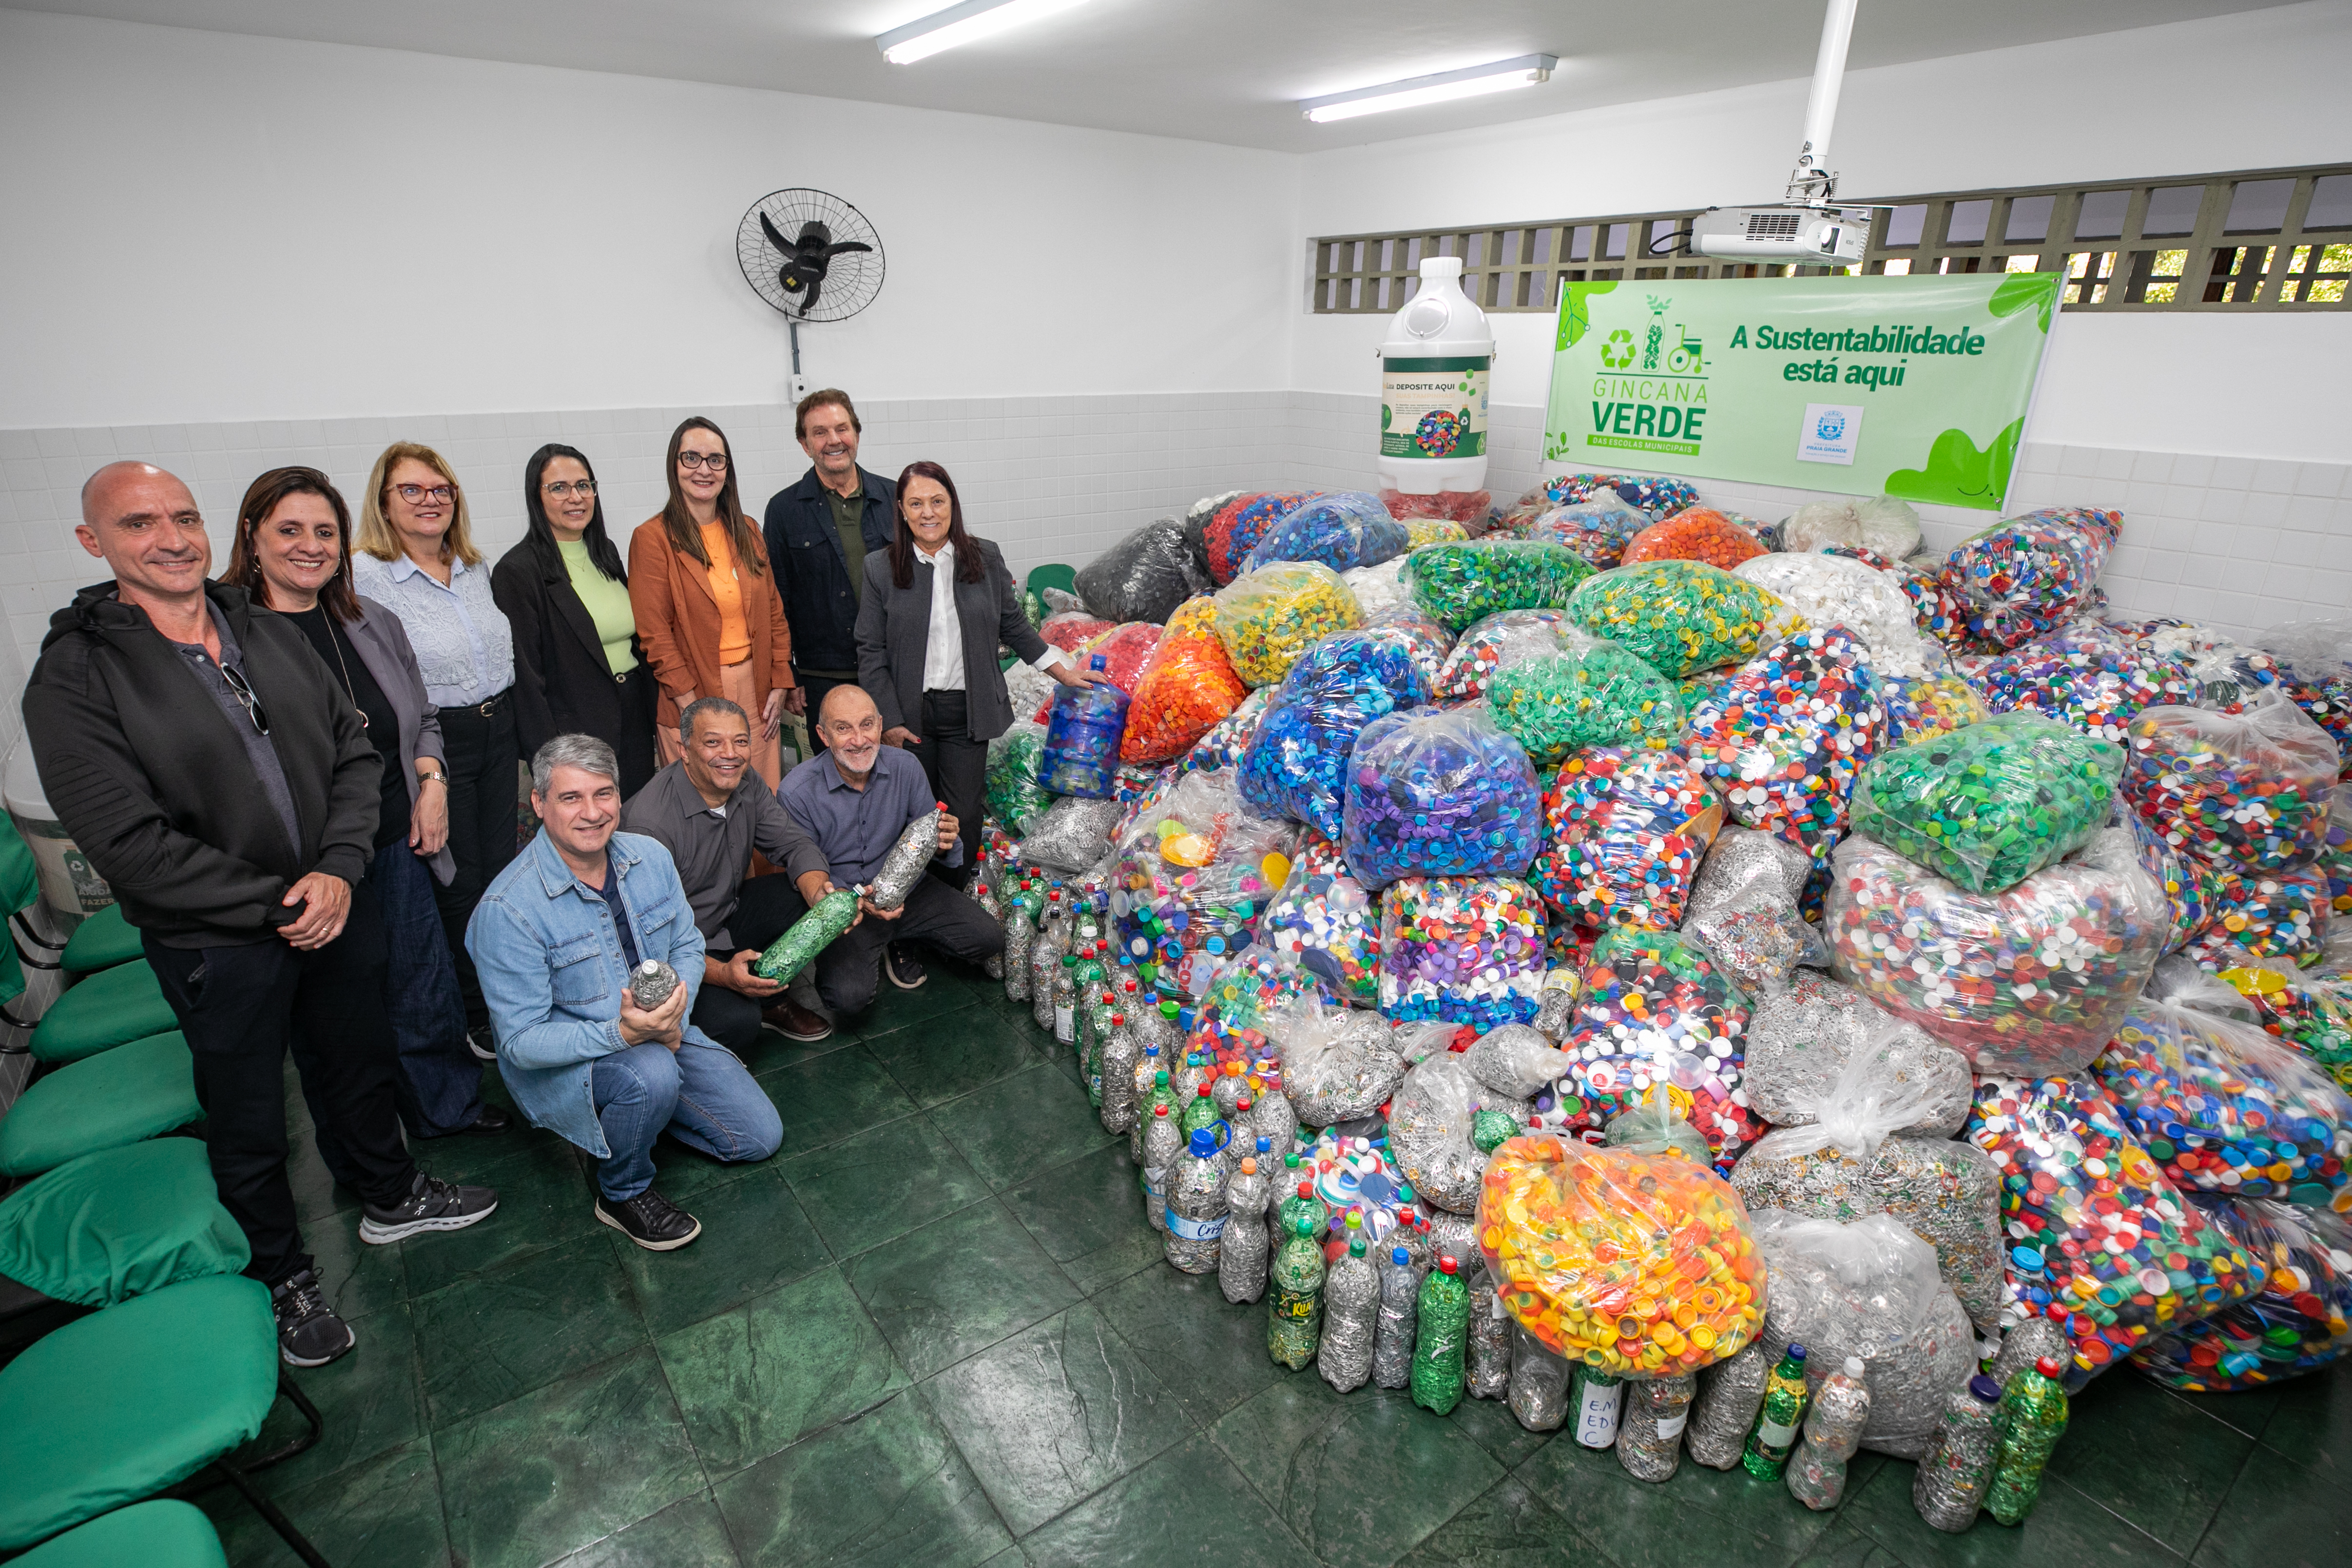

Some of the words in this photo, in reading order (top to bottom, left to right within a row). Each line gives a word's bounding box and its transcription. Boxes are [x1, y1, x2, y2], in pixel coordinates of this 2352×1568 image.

[1730, 326, 1748, 348] A
[1755, 325, 1985, 355] Sustentabilidade
[1783, 357, 1839, 383] está
[1844, 359, 1908, 392] aqui
[1593, 378, 1707, 404] GINCANA
[1592, 401, 1706, 441] VERDE
[1609, 439, 1643, 448] ESCOLAS
[1645, 442, 1693, 453] MUNICIPAIS
[1197, 1219, 1226, 1237] Crist
[1292, 1299, 1314, 1316] KUAT
